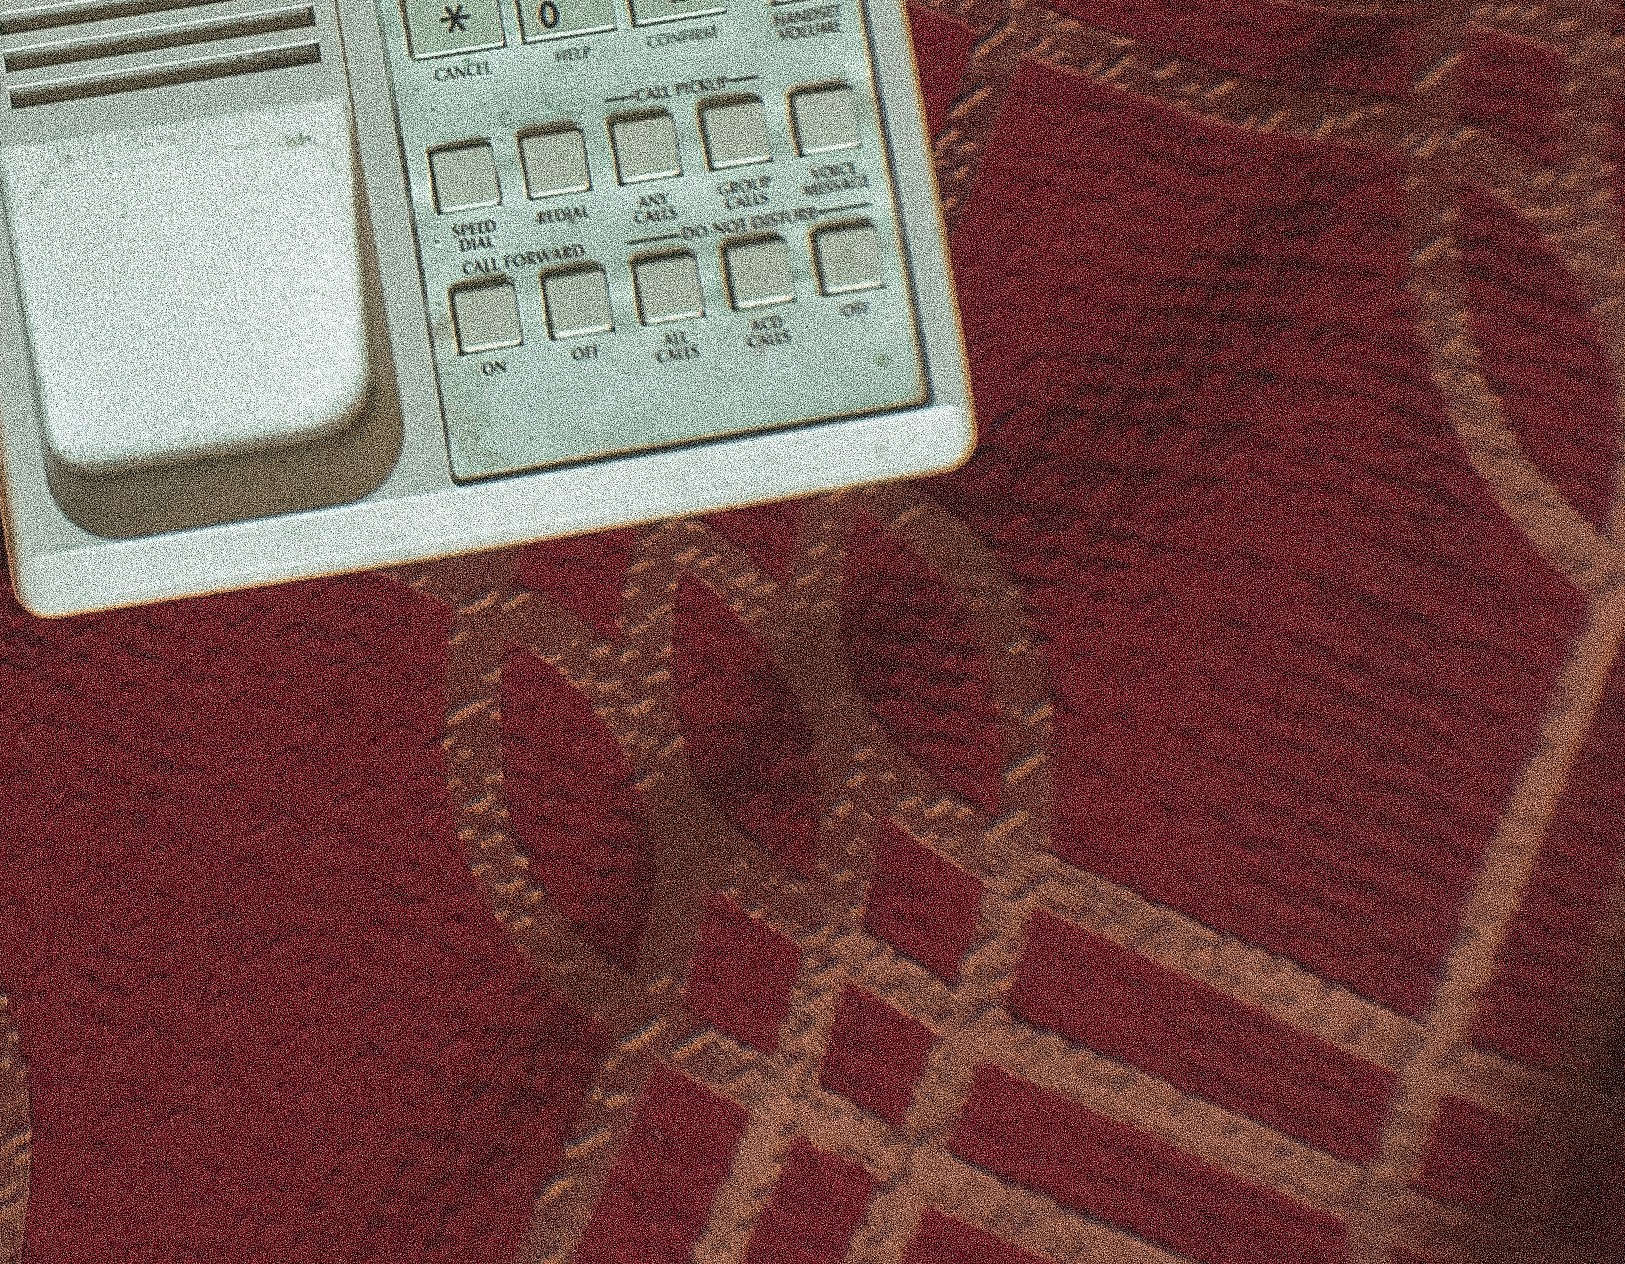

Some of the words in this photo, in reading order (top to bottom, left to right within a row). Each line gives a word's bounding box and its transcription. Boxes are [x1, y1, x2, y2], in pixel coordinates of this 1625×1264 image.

[536, 0, 560, 29] 0
[554, 46, 590, 62] HELP
[434, 61, 492, 82] CANCEL
[634, 86, 671, 101] CALL
[675, 76, 728, 93] PICKUP
[638, 193, 667, 208] ANY
[724, 193, 769, 210] CALLS
[536, 206, 588, 225] REDIAL
[632, 206, 678, 225] CALLS
[452, 219, 497, 237] SPEED
[680, 224, 709, 241] DO
[711, 217, 747, 236] NOT
[459, 236, 495, 253] DIAL
[462, 258, 500, 275] CALL
[505, 243, 586, 269] FORWARD
[746, 328, 791, 349] CALLS
[654, 344, 700, 363] CALLS
[481, 359, 507, 376] ON
